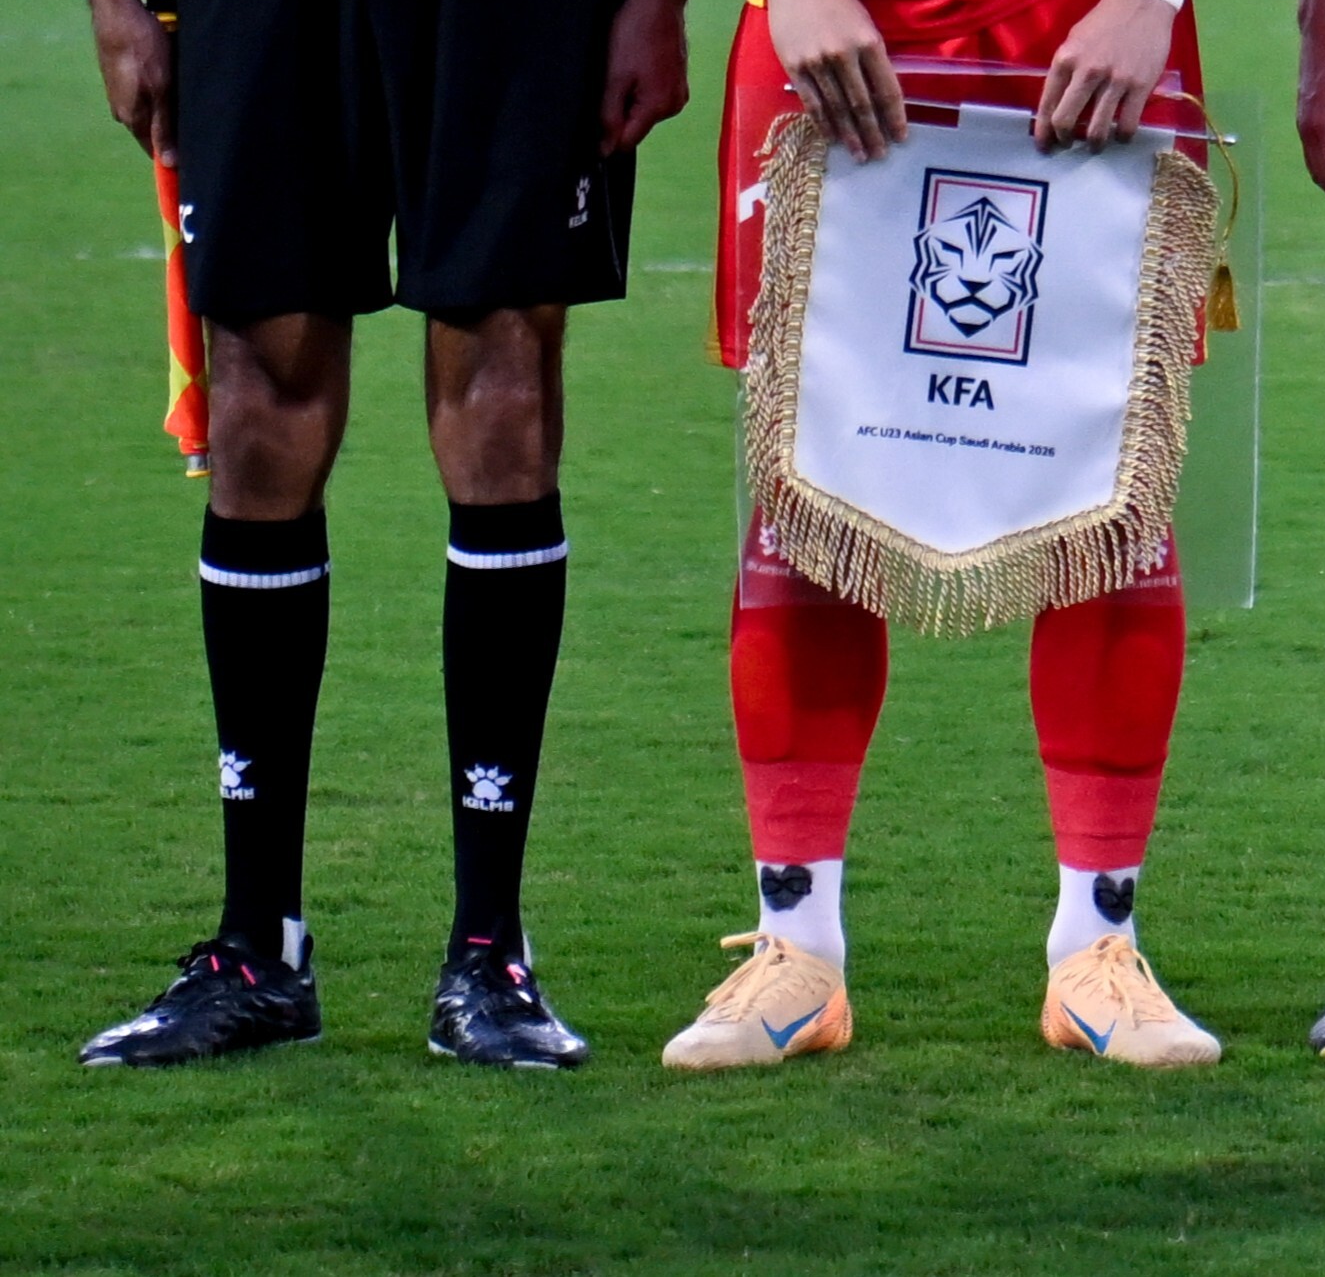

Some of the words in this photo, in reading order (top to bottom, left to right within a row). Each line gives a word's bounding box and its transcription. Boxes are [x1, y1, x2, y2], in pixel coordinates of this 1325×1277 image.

[927, 373, 995, 411] KFA
[857, 426, 878, 437] AFC
[880, 427, 901, 439] U23
[904, 429, 933, 442] Asian
[936, 432, 957, 446] Cup
[959, 435, 989, 448] Saudi
[991, 439, 1026, 453] Arabia
[1028, 444, 1056, 457] 2026
[462, 794, 514, 812] KELME
